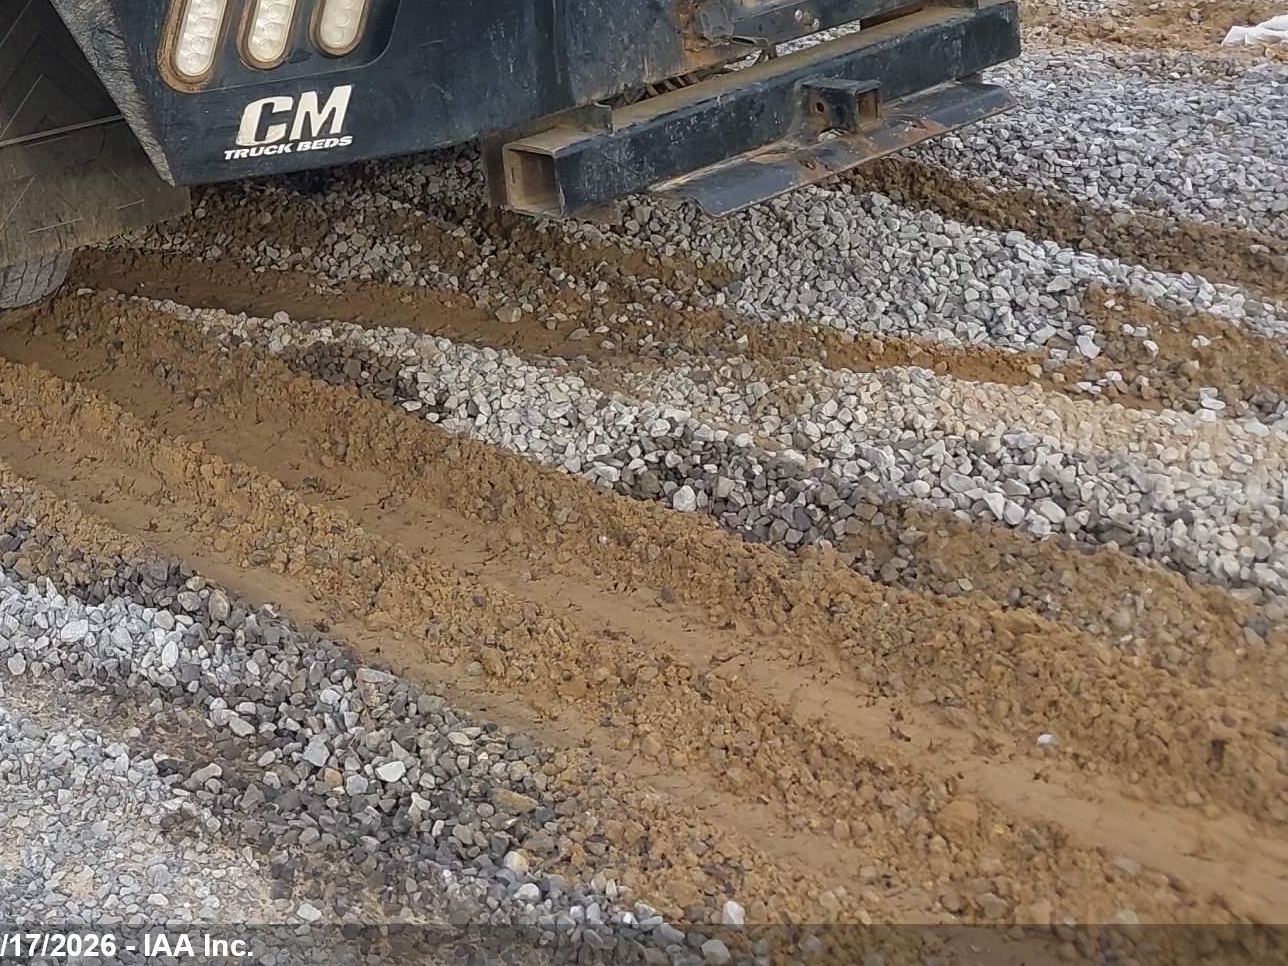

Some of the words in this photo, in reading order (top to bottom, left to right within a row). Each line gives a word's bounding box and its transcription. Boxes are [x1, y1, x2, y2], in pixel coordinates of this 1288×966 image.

[235, 85, 352, 146] CM
[224, 143, 294, 160] TRUCK
[296, 135, 353, 152] BEDS
